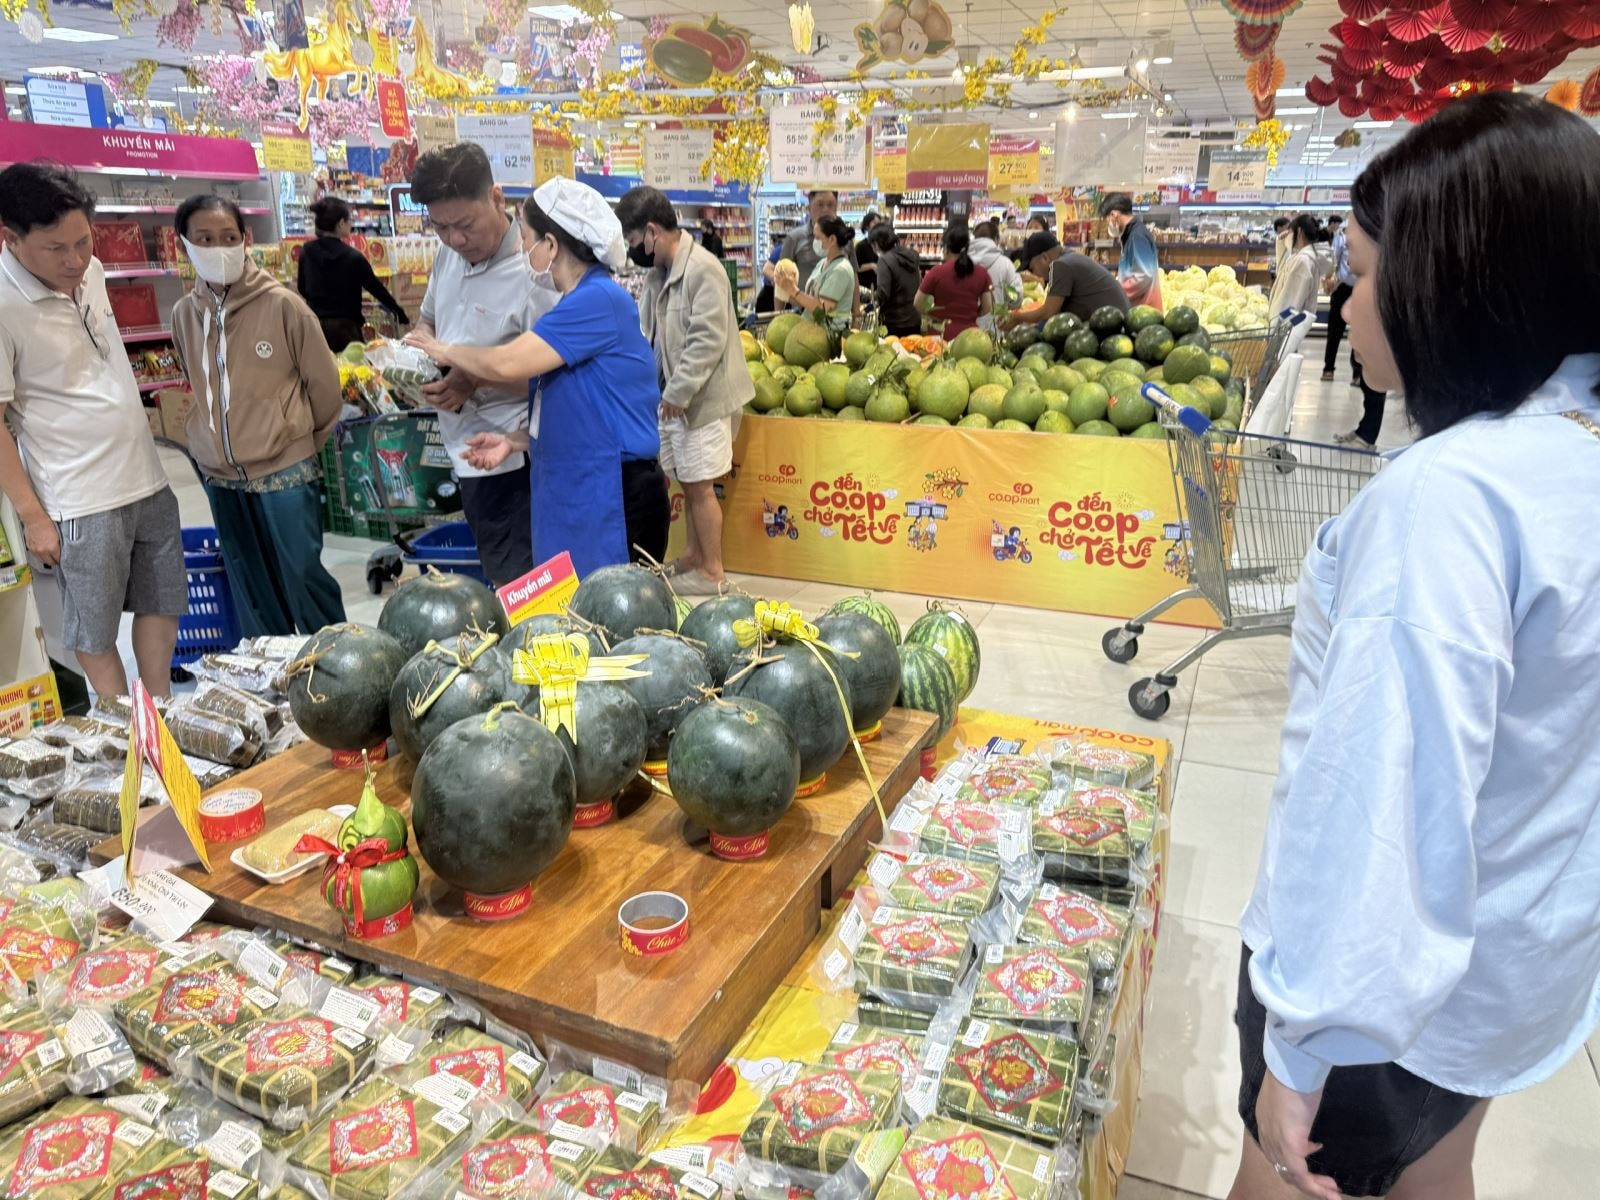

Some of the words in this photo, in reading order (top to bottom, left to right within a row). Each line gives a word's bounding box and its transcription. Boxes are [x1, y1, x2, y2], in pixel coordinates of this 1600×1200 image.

[800, 110, 821, 119] BẢNG
[103, 135, 151, 150] KHUYẾN
[154, 138, 175, 152] MÃI
[834, 473, 862, 492] đến
[810, 481, 886, 520] Co.op
[988, 491, 1040, 505] co.opmart
[1077, 492, 1111, 512] đến
[804, 506, 833, 526] chở
[834, 514, 893, 544] Tết
[1048, 501, 1139, 544] Co.op
[1039, 528, 1074, 550] chở
[1076, 536, 1146, 569] Tết
[507, 577, 538, 606] Khuyến
[537, 568, 552, 586] mãi
[1034, 720, 1154, 746] co.opmart
